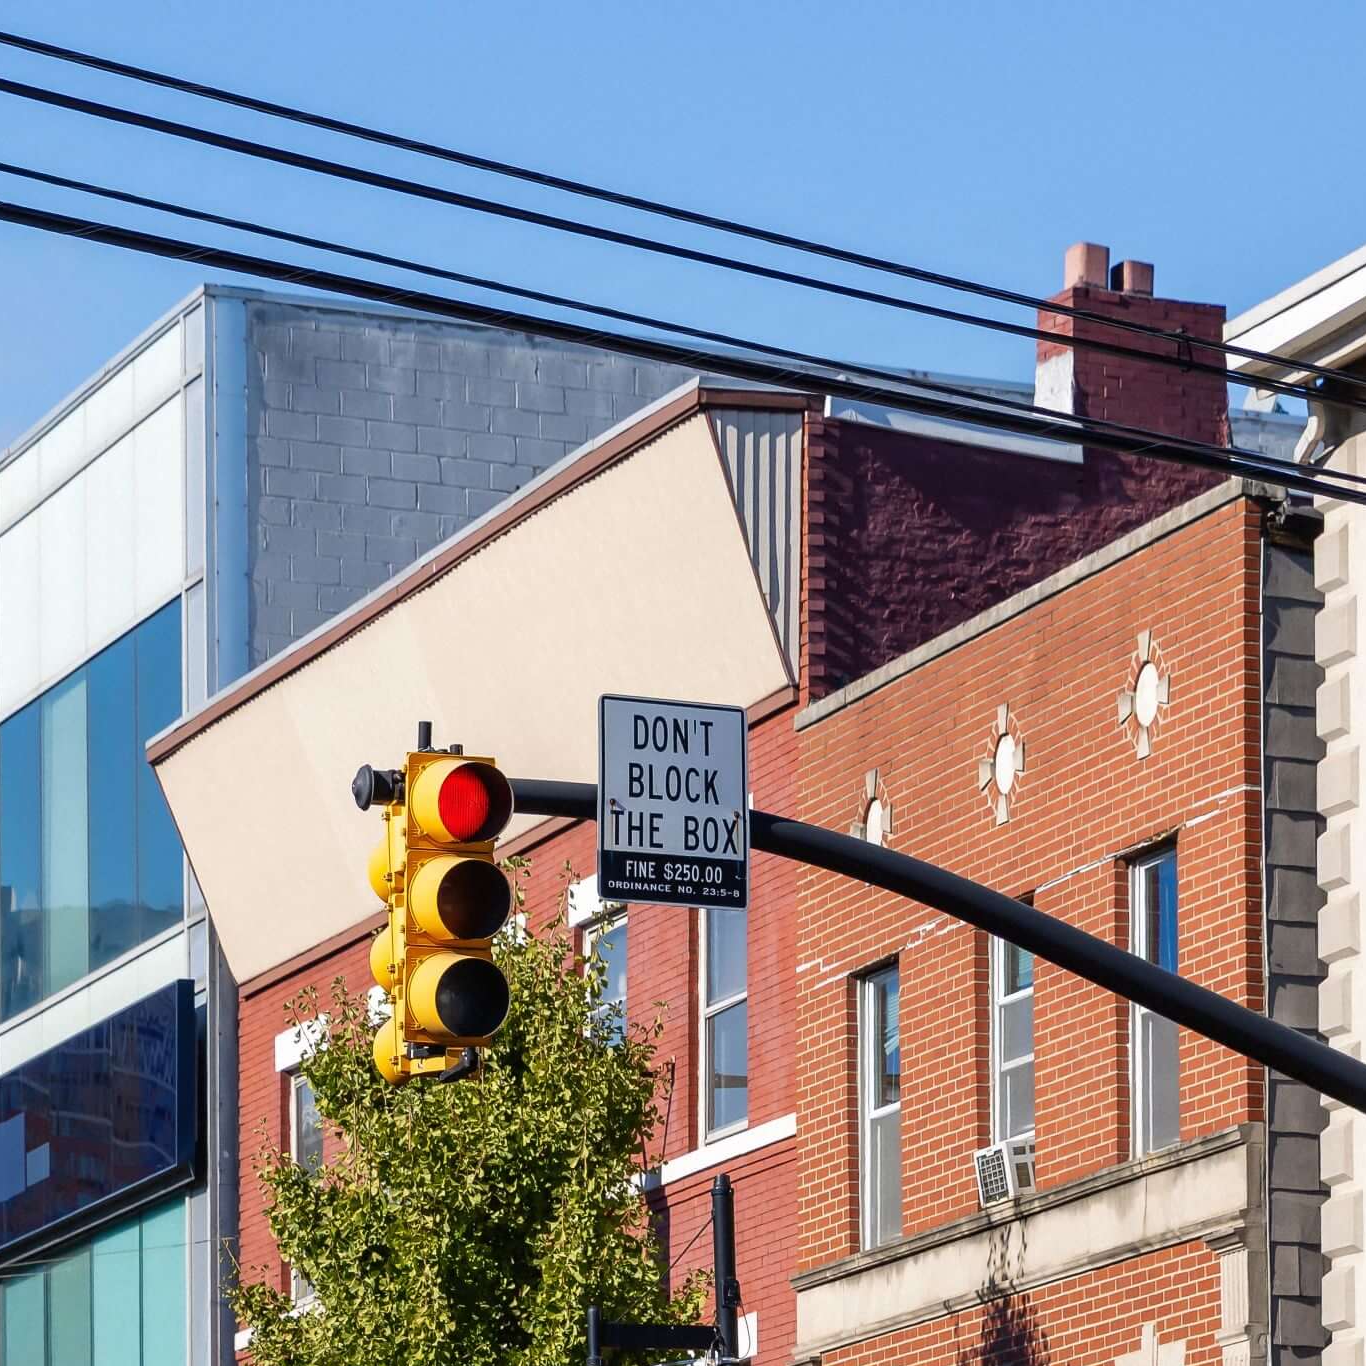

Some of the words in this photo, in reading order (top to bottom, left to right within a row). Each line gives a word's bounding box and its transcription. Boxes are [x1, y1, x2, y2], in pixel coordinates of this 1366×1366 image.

[633, 714, 714, 757] DON'T
[628, 762, 720, 806] BLOCK
[610, 808, 664, 849] THE
[683, 815, 738, 855] BOX
[608, 880, 672, 893] ORDINANCE
[677, 885, 697, 895] NO.
[702, 886, 740, 898] 23:5-8
[626, 859, 656, 880] FINE
[664, 861, 723, 884] $250.00
